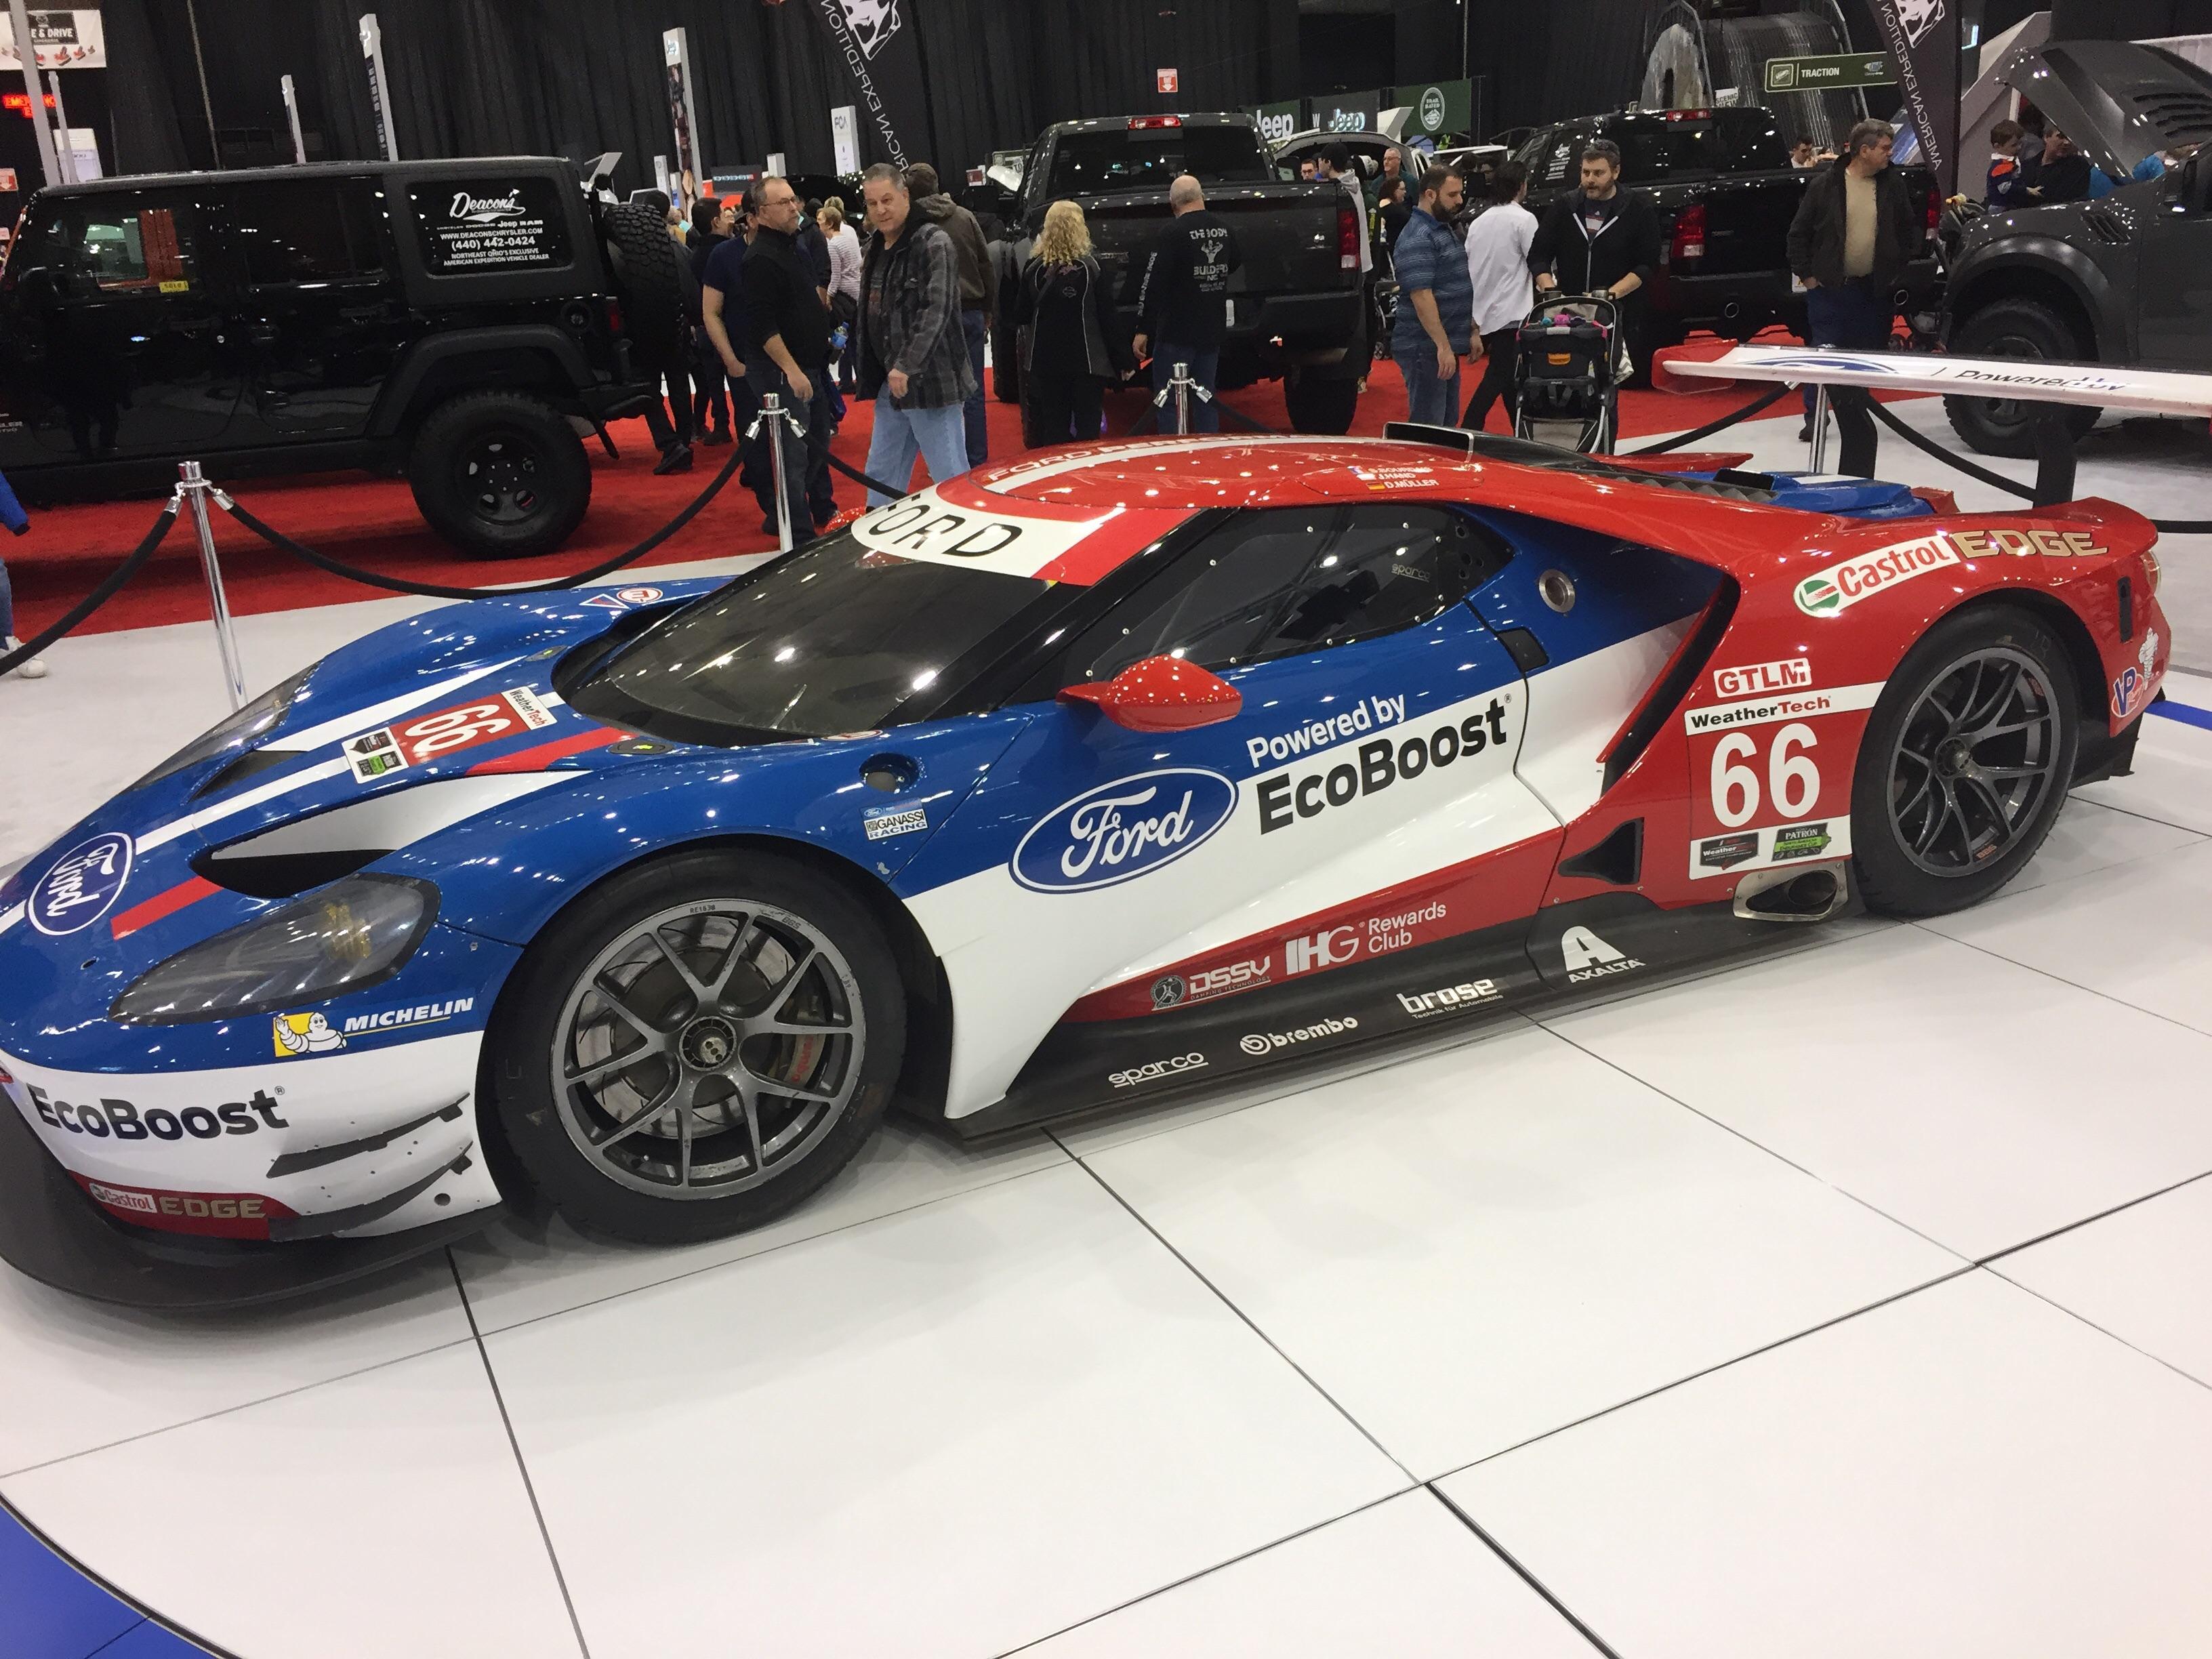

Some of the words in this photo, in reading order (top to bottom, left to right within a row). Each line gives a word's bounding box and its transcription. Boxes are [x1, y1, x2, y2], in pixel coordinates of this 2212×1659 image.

[47, 28, 73, 38] DRIVE
[1801, 67, 1840, 78] TRACTION
[1328, 108, 1367, 132] Jeep
[440, 227, 544, 240] WWW.DEACONSCHRYSLER.COM
[497, 220, 518, 228] Jeep
[451, 239, 480, 251] (440)
[483, 236, 536, 248] 442-0424
[451, 251, 487, 260] NORTHEAST
[508, 247, 539, 255] EXCLUSIVE
[474, 256, 506, 264] EXPEDITION
[529, 253, 550, 261] DEALER
[987, 450, 1092, 481] FORD
[1384, 478, 1440, 489] D.MÜLLER
[868, 500, 1023, 558] ORD
[1836, 539, 1951, 597] Castrol
[1948, 529, 2108, 558] EDGE
[1717, 661, 1807, 694] GTLM
[2112, 667, 2137, 717] VP
[509, 689, 548, 726] WeatherTech
[1690, 697, 1830, 729] WeatherTech
[405, 703, 511, 753] 66
[1246, 699, 1372, 769] Powered
[1376, 693, 1406, 725] by
[1710, 722, 1820, 828] 66
[869, 821, 927, 838] RACING
[878, 811, 925, 830] GANASSI
[1061, 786, 1194, 878] Ford
[46, 842, 119, 917] Ford
[1368, 901, 1447, 935] Rewards
[1286, 925, 1360, 975] IHG
[1368, 928, 1412, 954] Club
[1189, 955, 1271, 995] DSSV
[1568, 959, 1645, 984] AXALTA
[1190, 989, 1223, 1000] DAMPING
[1224, 976, 1271, 991] TECHNOLOGY
[1396, 979, 1498, 1014] brose
[344, 997, 474, 1032] MICHELIN
[1412, 1008, 1445, 1019] Technik
[1458, 994, 1504, 1008] Automobile
[1267, 1017, 1358, 1047] brembo
[1108, 1052, 1206, 1086] sparco
[104, 1189, 153, 1211] Castrol
[159, 1195, 266, 1218] EDGE
